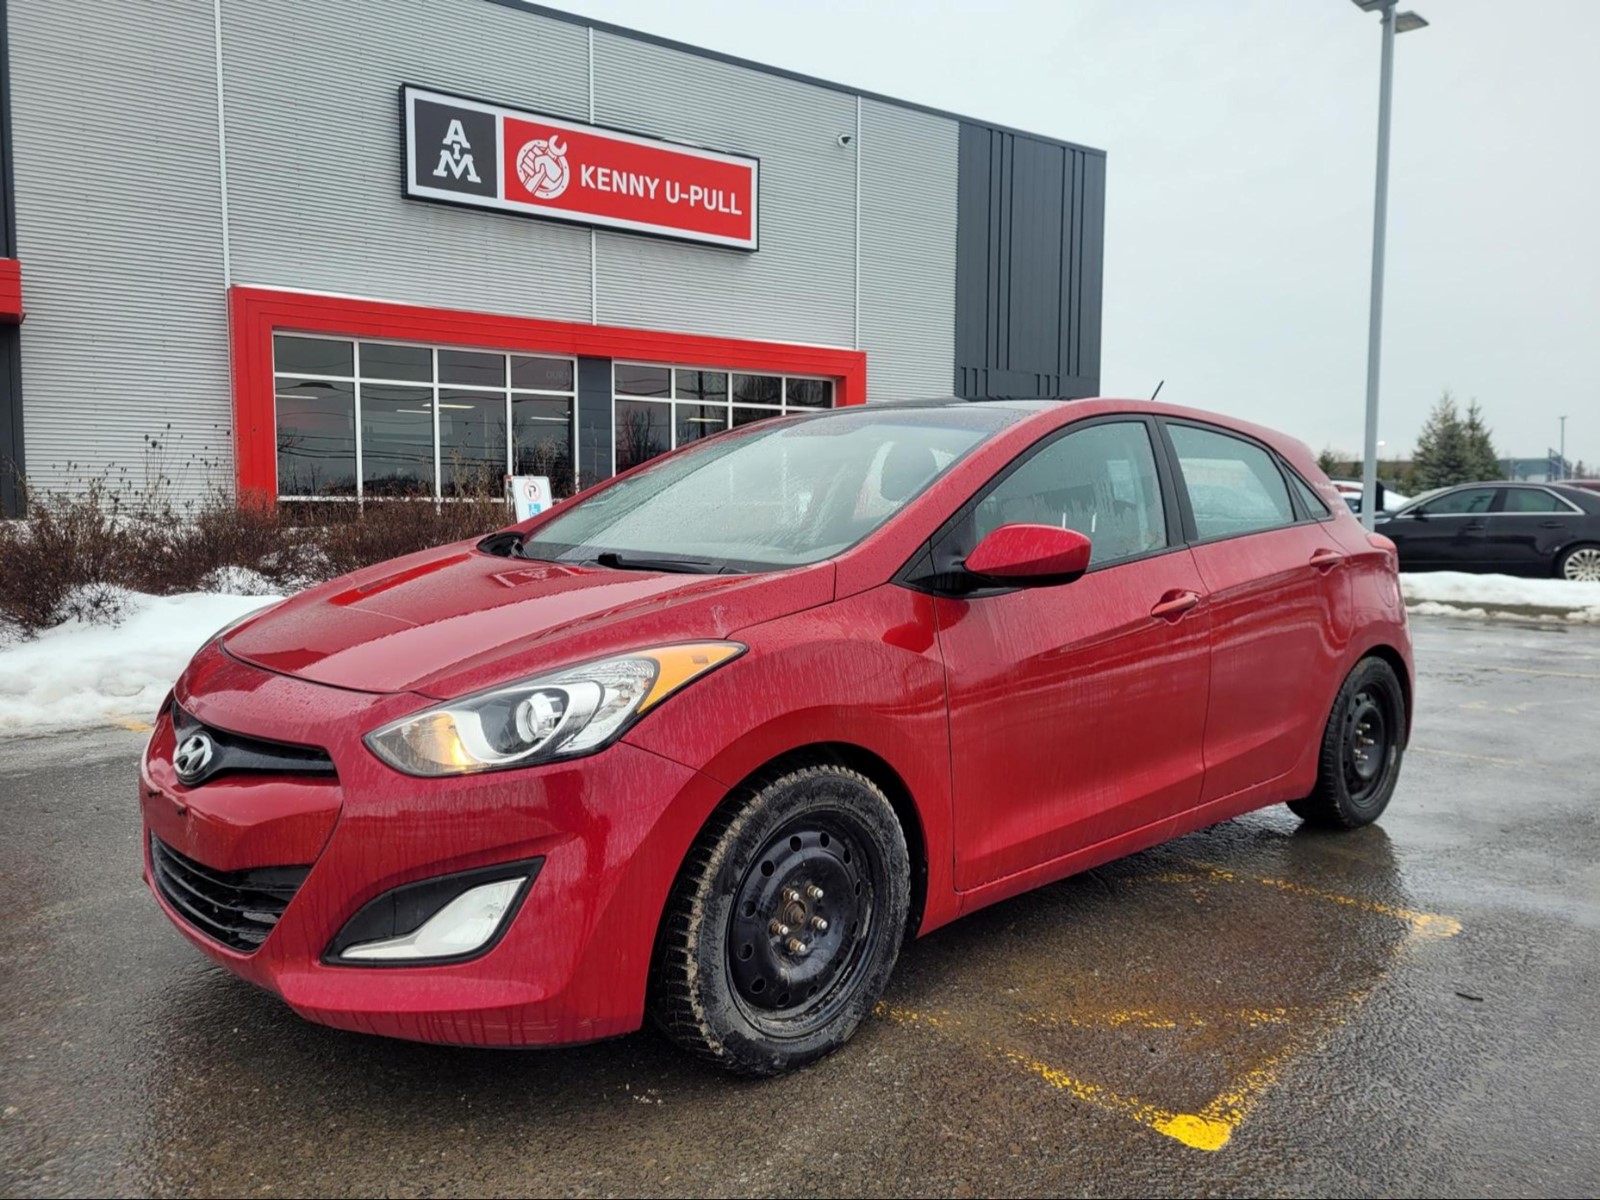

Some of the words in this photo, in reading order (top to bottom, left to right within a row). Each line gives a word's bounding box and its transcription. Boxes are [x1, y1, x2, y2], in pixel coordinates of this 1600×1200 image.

[432, 119, 482, 183] AIM
[580, 163, 660, 200] KENNY
[665, 179, 743, 215] U-PULL
